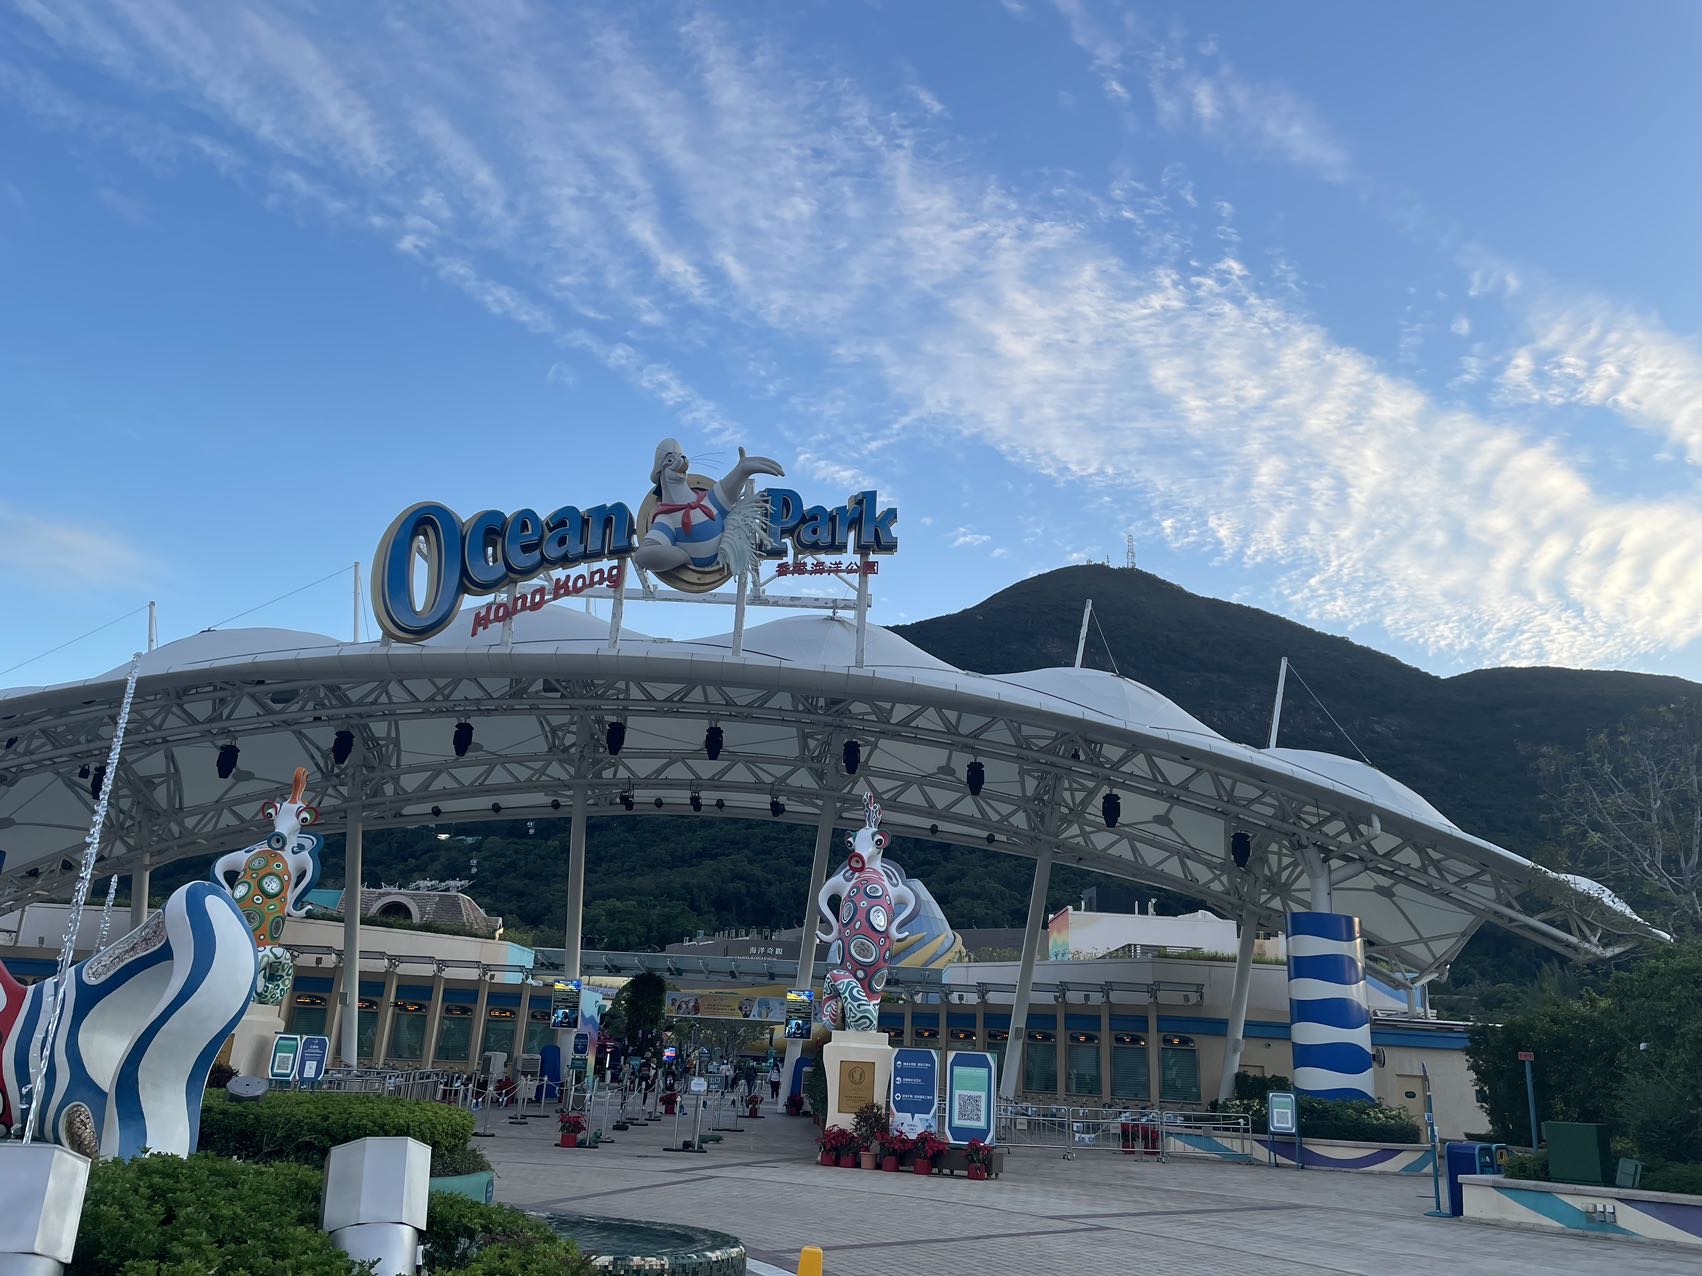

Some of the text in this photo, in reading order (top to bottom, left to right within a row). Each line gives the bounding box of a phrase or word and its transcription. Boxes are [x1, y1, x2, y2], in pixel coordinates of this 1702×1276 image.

[371, 488, 898, 642] Ocean Park
[471, 565, 622, 637] Hong Kong
[776, 561, 878, 577] 香港海洋公園
